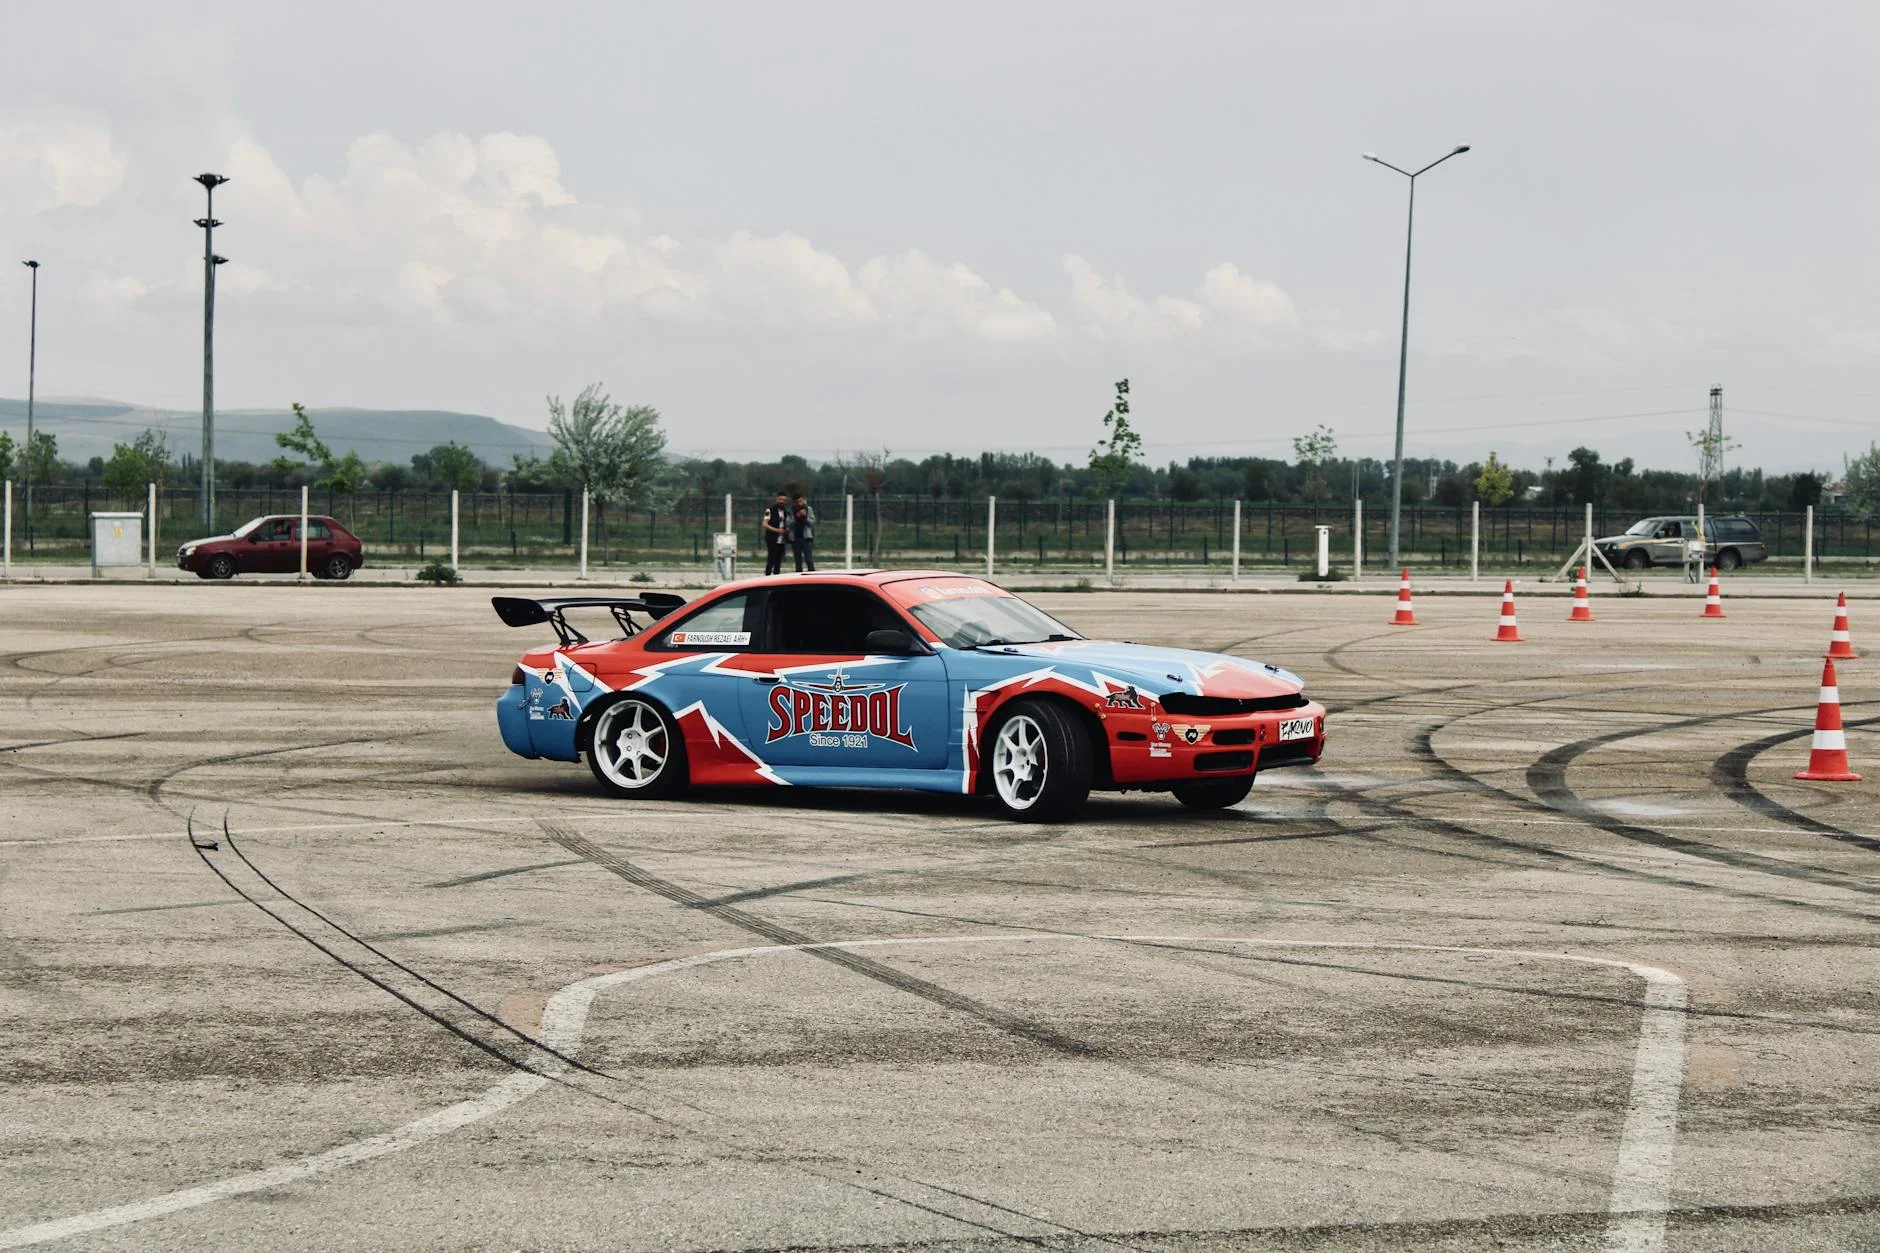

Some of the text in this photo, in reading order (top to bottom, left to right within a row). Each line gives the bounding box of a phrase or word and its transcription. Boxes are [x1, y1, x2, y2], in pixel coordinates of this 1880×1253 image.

[765, 682, 918, 752] SPEEDOL
[810, 734, 868, 748] Since 1921
